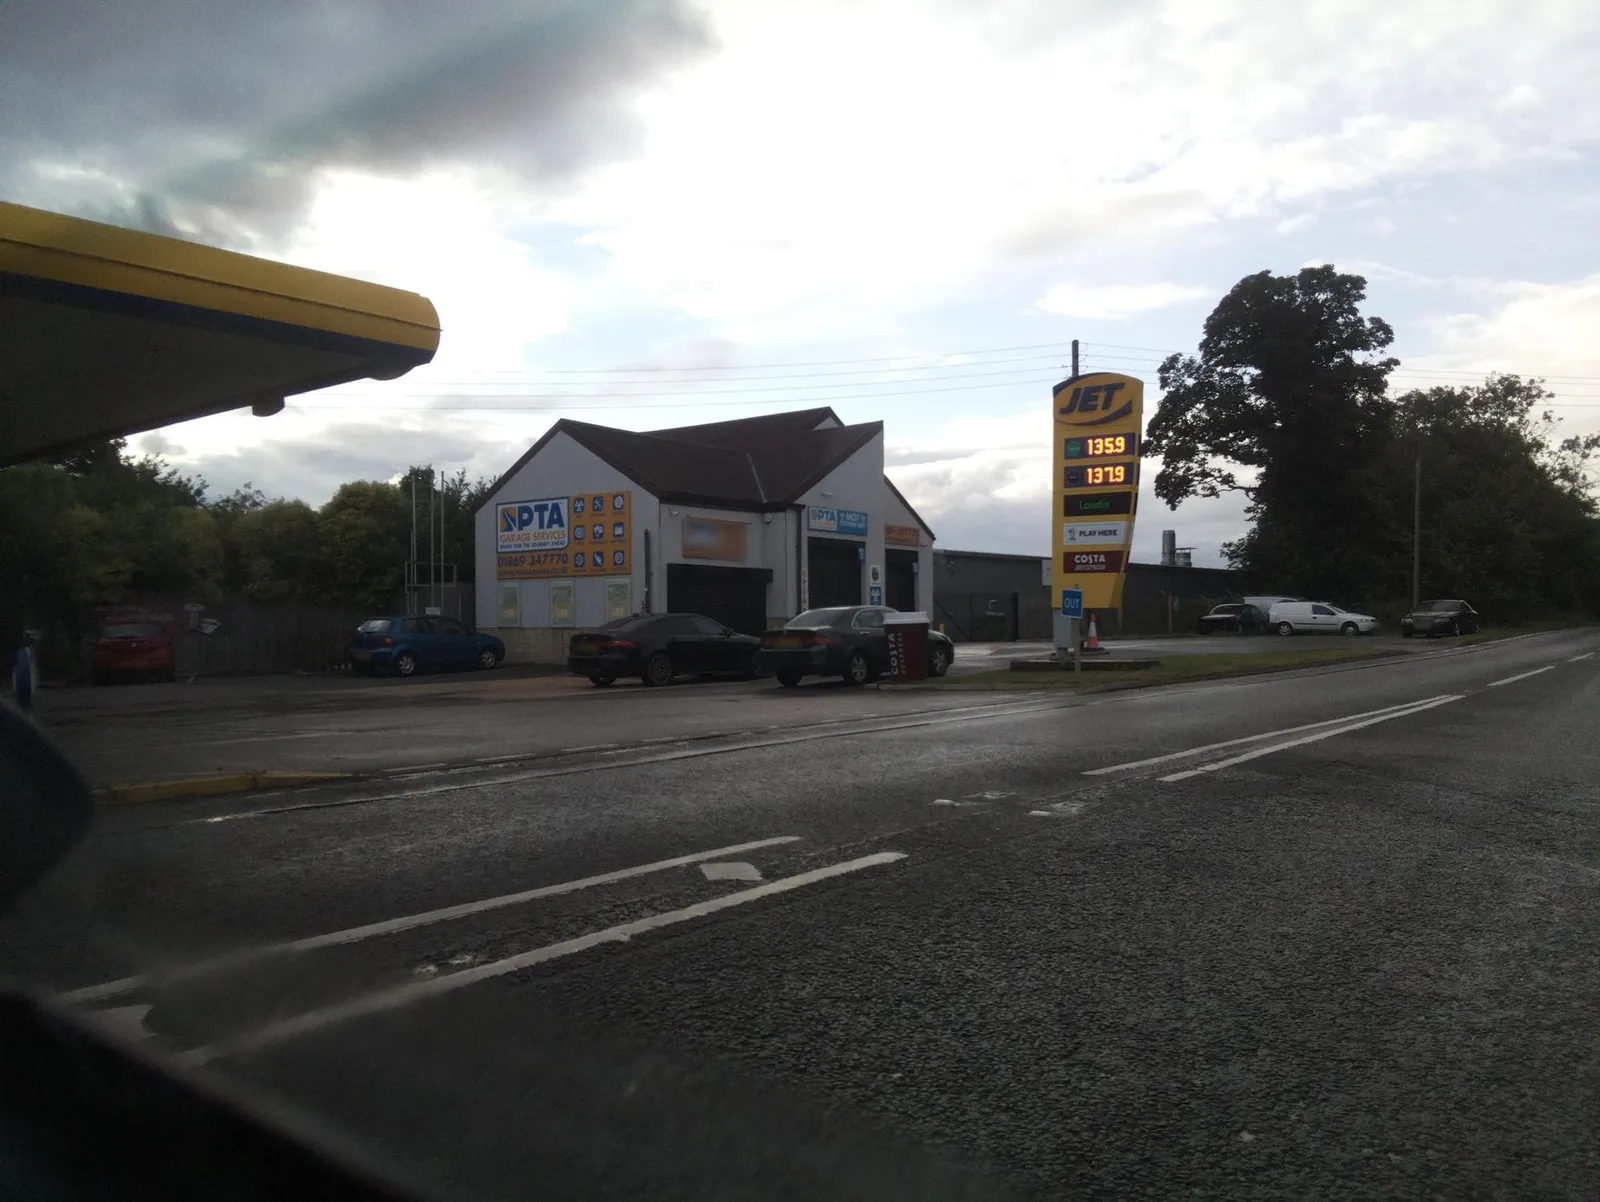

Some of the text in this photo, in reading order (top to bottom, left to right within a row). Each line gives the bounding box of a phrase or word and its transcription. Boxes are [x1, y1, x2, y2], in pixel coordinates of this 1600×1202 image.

[1059, 383, 1126, 414] JET
[517, 502, 565, 531] PTA
[500, 530, 567, 544] GARAGE SERVICES
[1079, 528, 1118, 538] PLAY HERE
[529, 552, 569, 566] 347770
[1074, 554, 1106, 565] COSTA
[1064, 598, 1080, 609] OUT
[888, 632, 899, 676] COSTA
